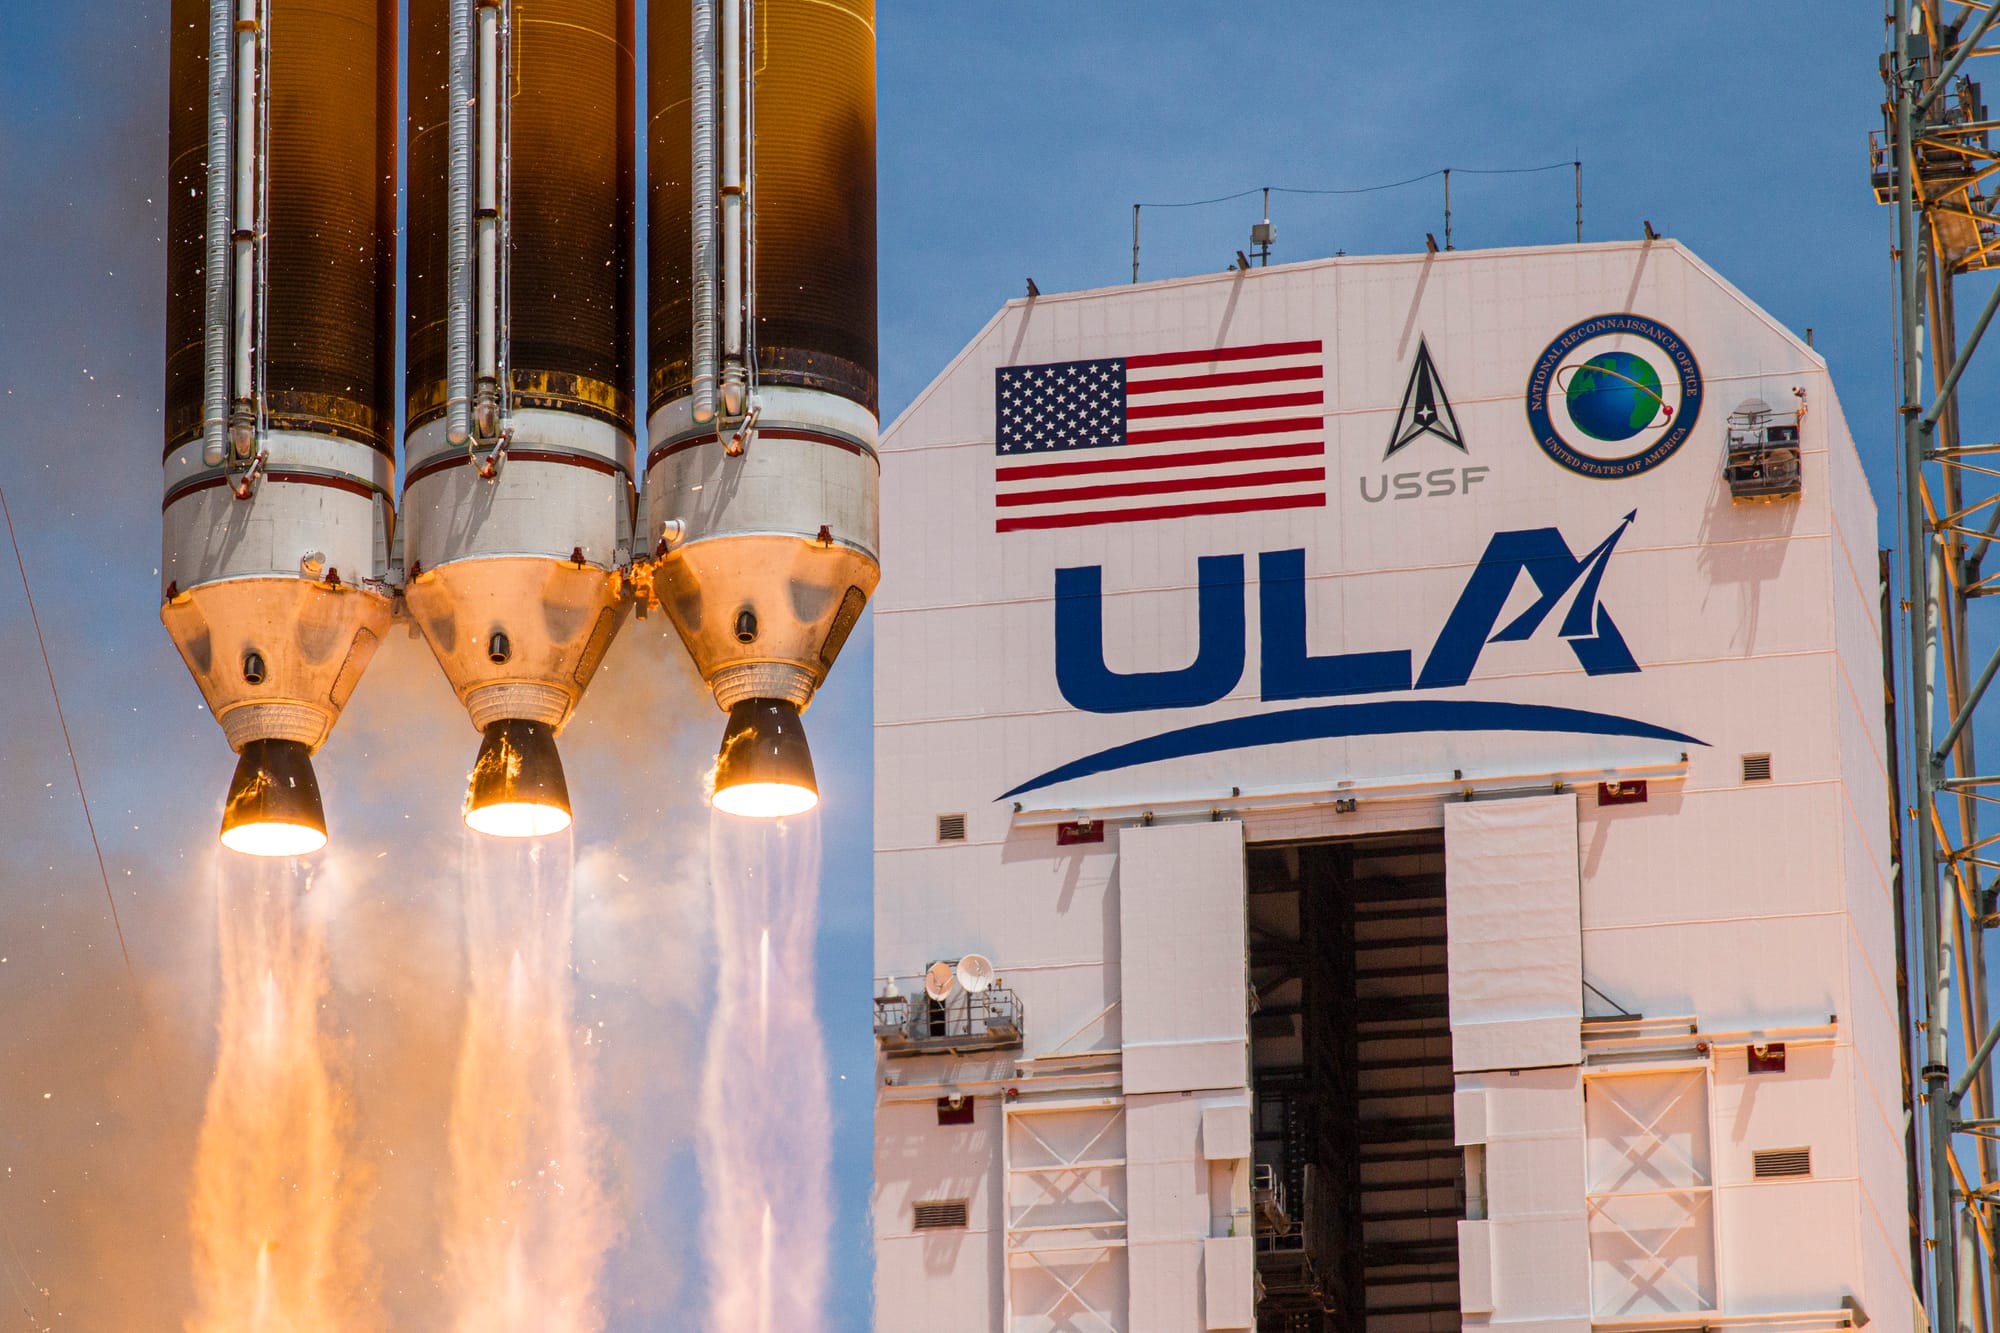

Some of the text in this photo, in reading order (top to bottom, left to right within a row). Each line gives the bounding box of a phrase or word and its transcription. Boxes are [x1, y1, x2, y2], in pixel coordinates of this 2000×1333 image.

[1532, 319, 1698, 411] NATIONAL RECONNAISSANCE OFFICE
[1360, 466, 1490, 503] USSF
[1544, 427, 1687, 475] UNITED STATES OF AMERICA
[1055, 509, 1641, 714] ULA
